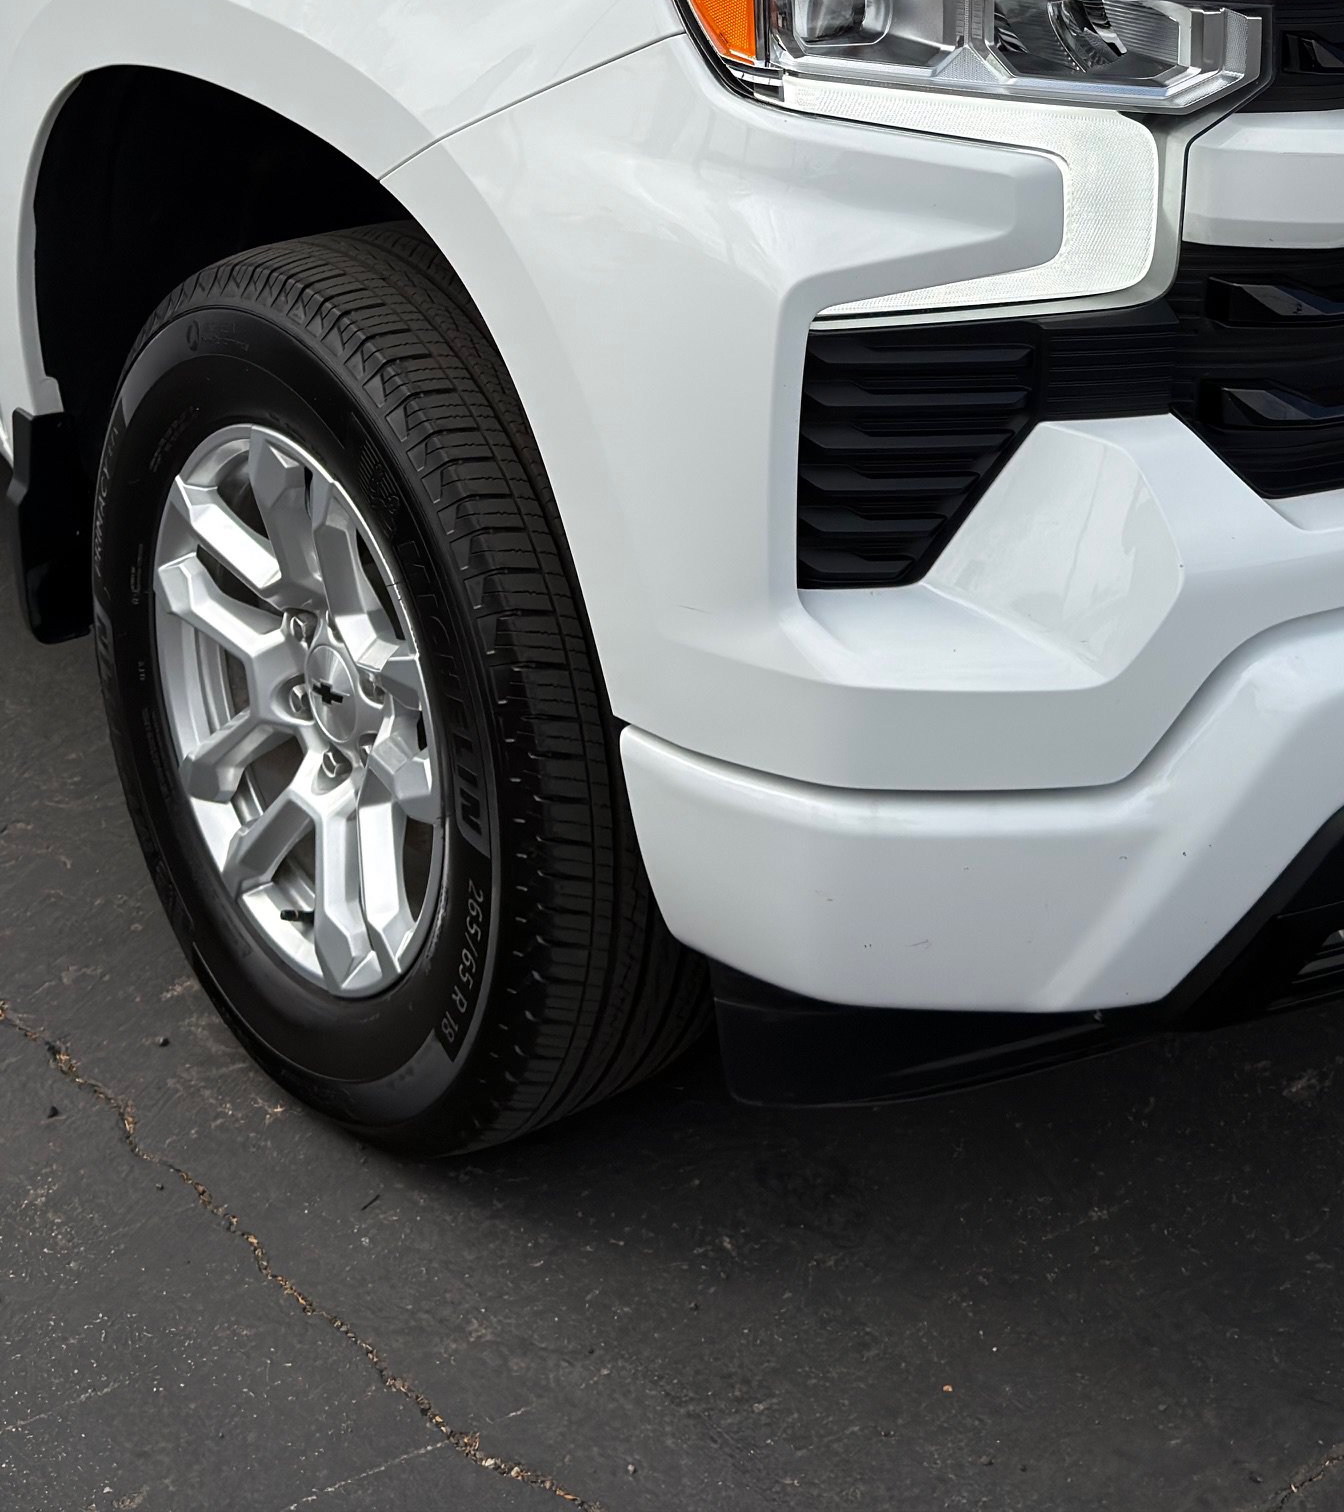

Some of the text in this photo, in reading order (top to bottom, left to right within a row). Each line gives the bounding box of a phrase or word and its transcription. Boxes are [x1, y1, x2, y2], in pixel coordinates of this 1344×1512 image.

[440, 878, 484, 1044] 265/65 R 18
